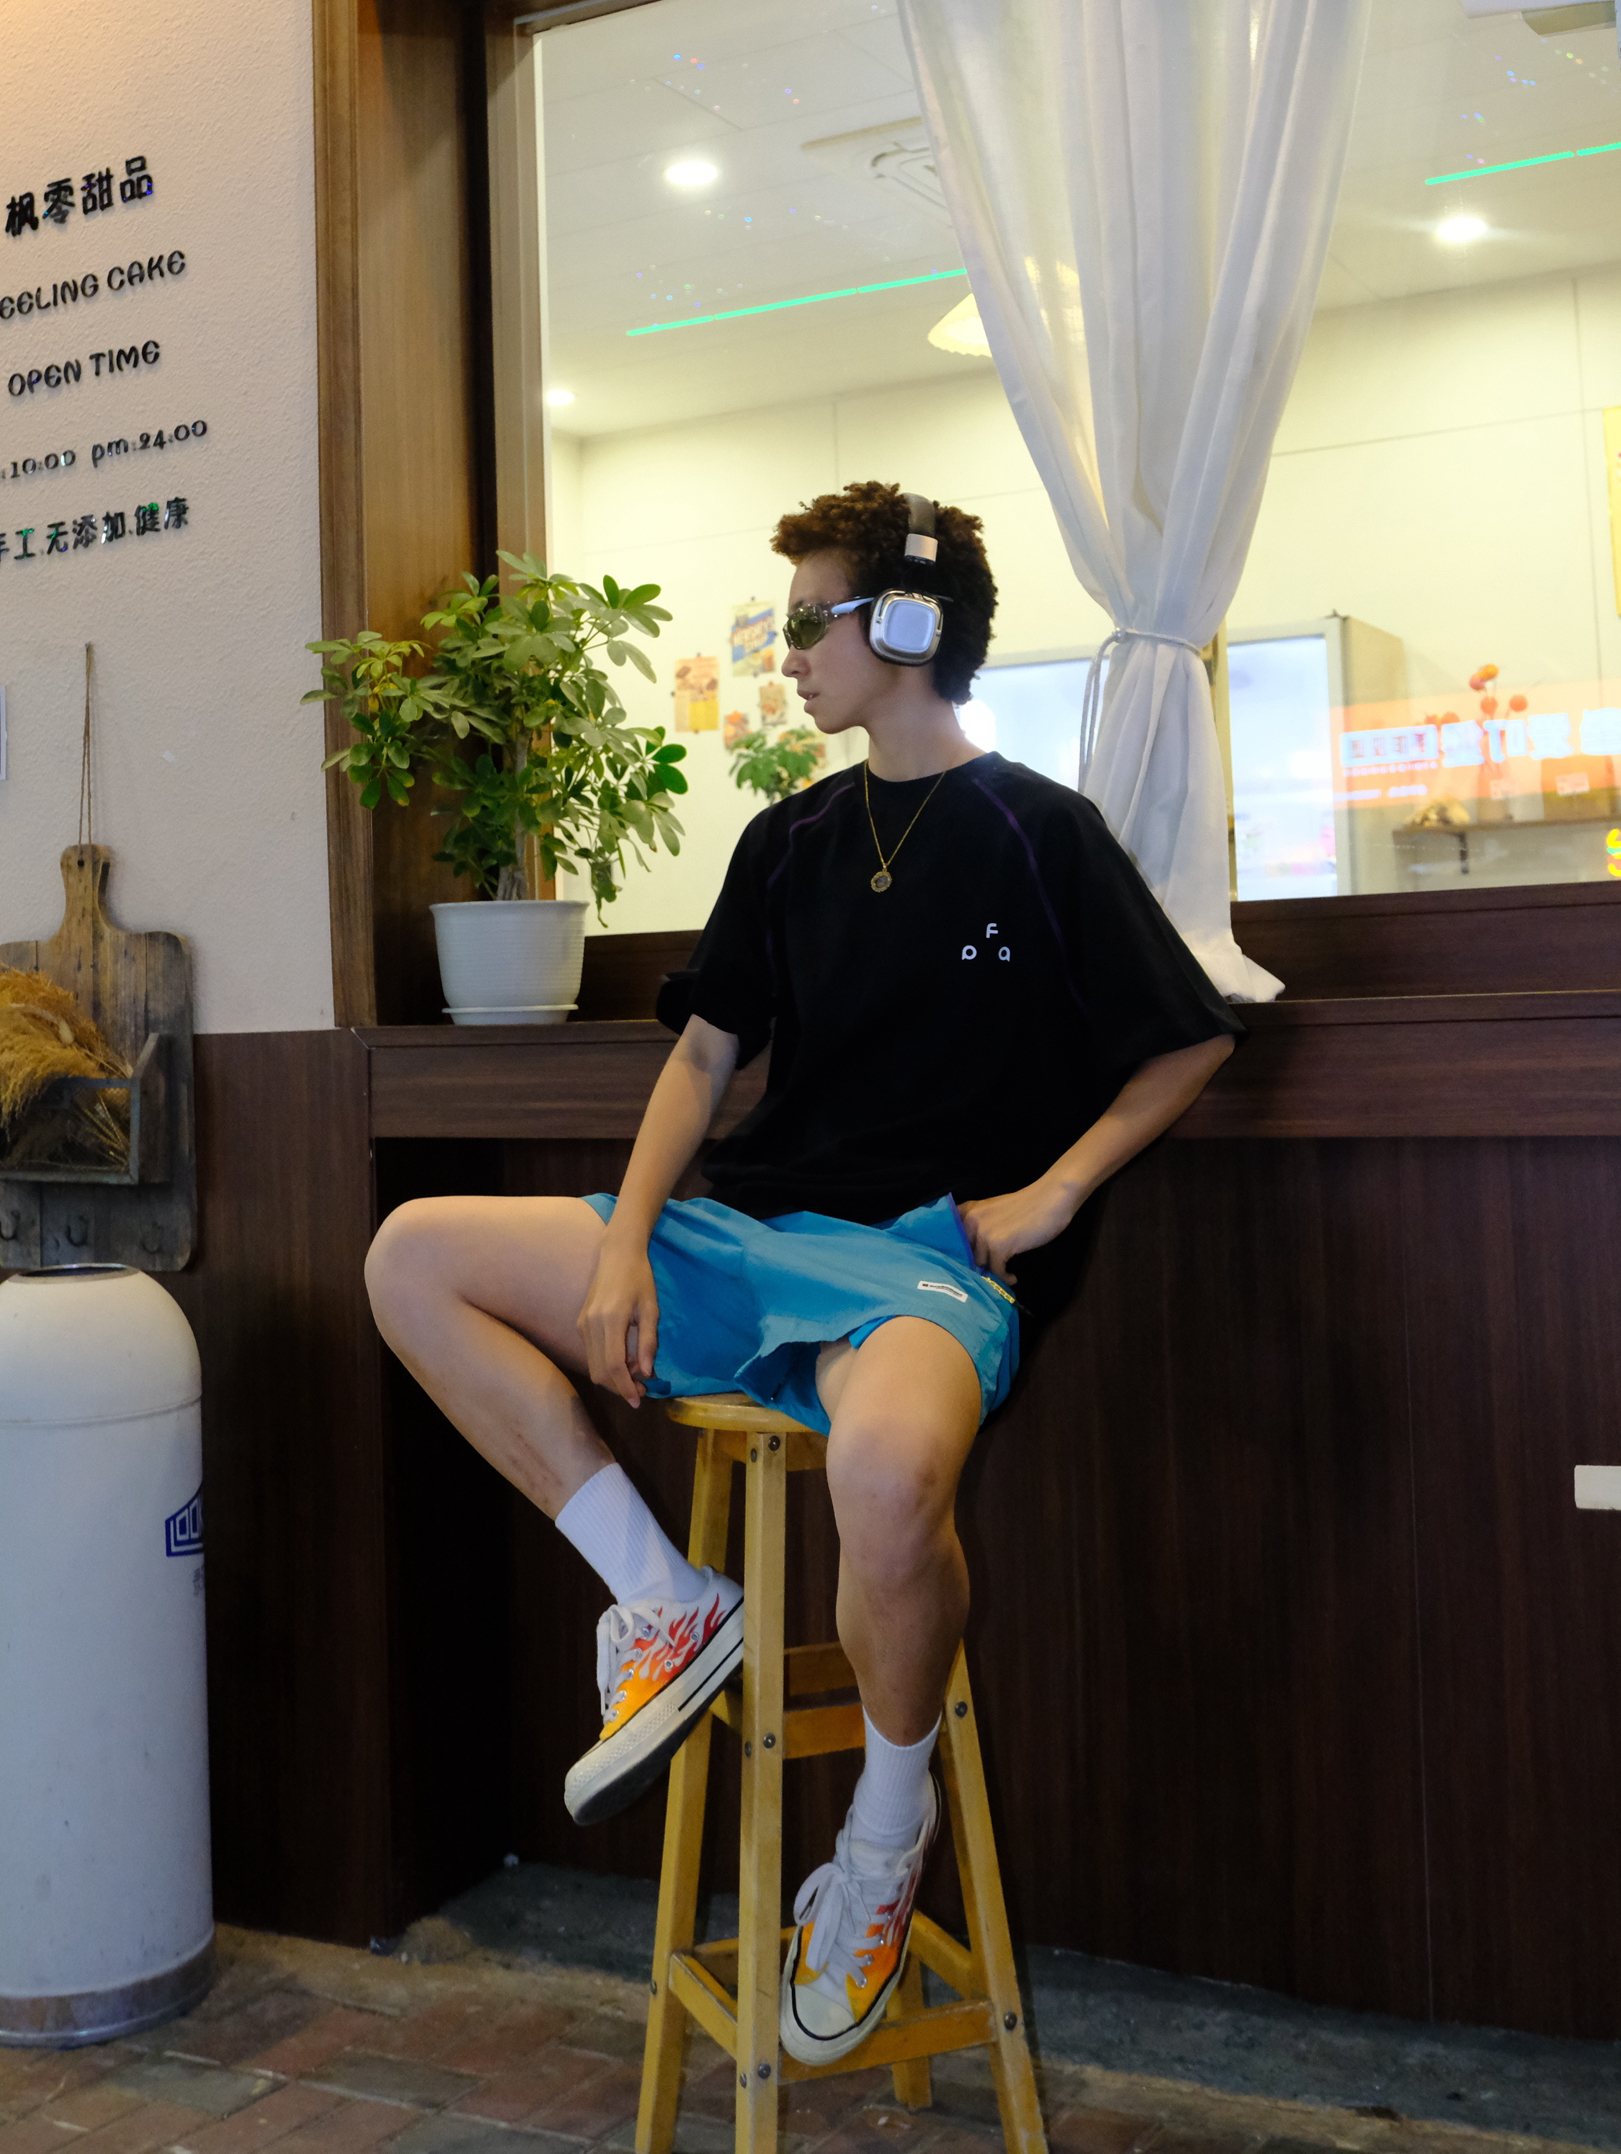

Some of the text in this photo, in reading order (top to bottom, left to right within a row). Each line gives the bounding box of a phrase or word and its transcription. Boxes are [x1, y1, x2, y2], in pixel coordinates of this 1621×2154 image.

[5, 155, 153, 237] 枫零甜品
[107, 250, 186, 291] CAKE
[8, 340, 160, 397] OPEN TIME
[985, 922, 999, 939] F
